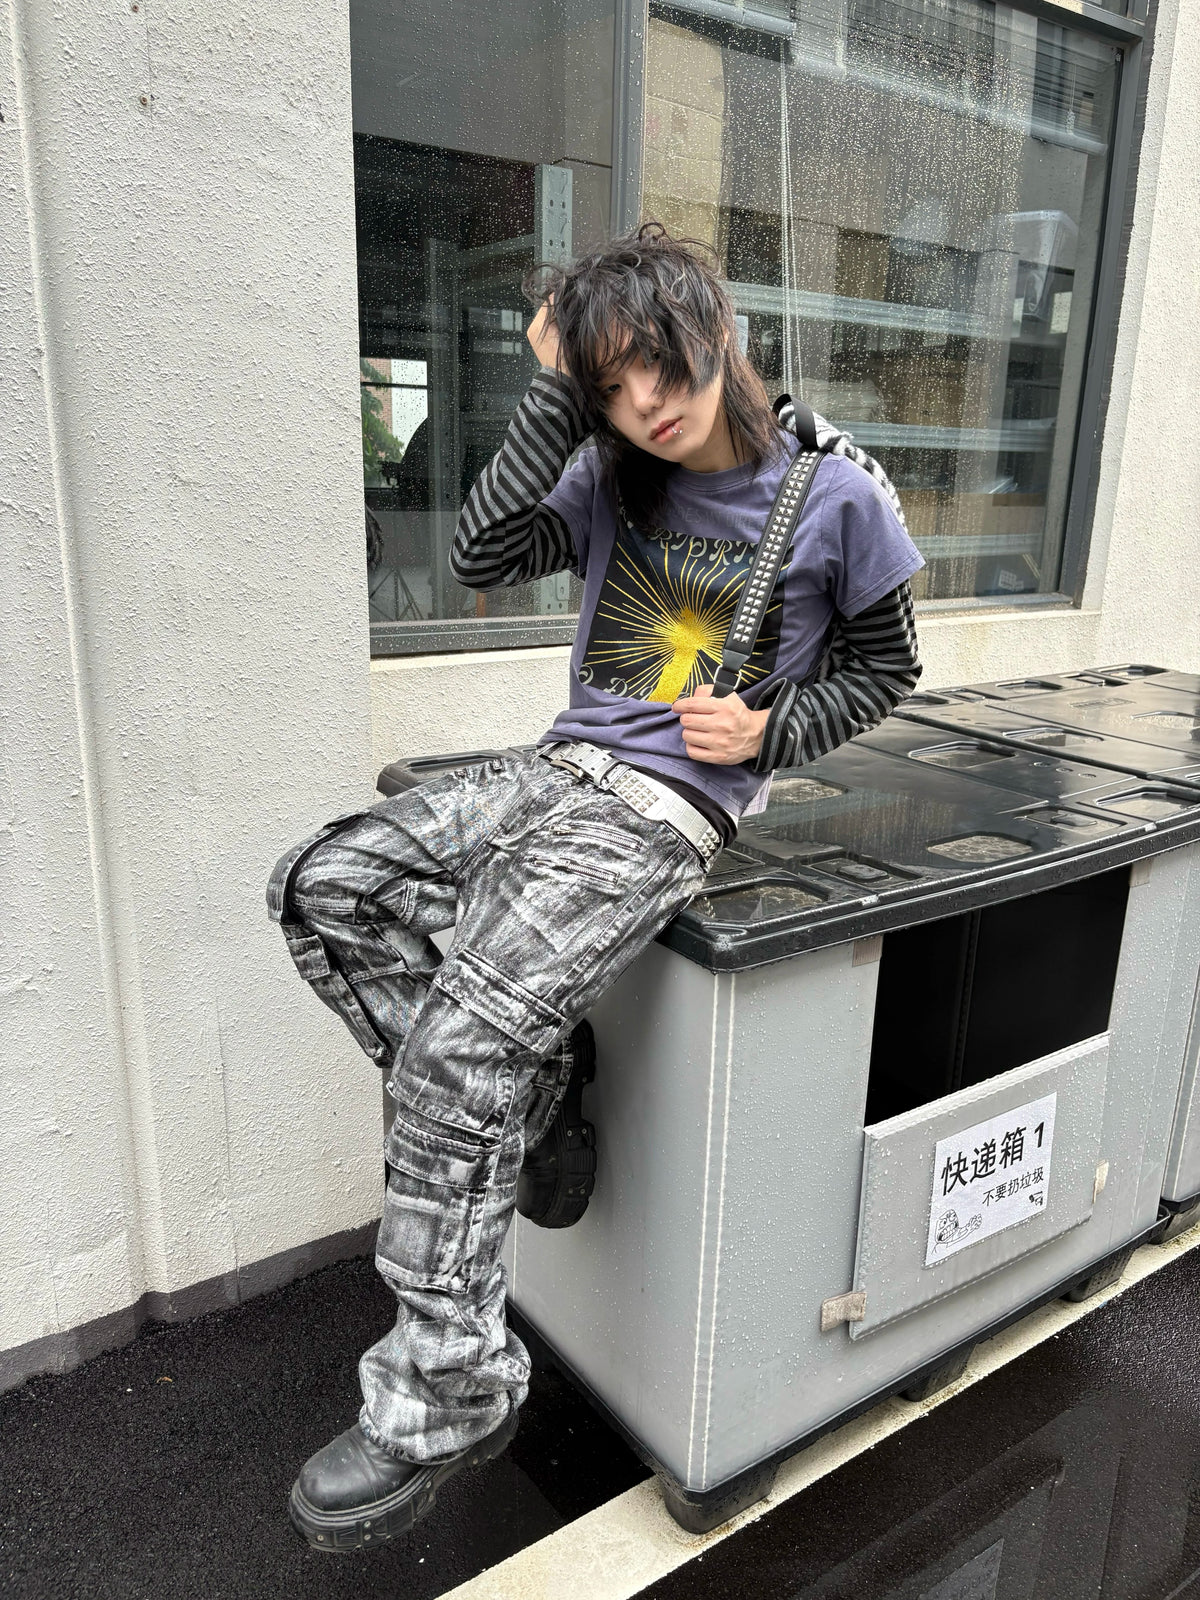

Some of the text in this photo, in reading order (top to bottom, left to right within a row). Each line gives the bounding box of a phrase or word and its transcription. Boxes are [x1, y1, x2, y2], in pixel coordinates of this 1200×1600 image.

[941, 1121, 1045, 1196] 快递箱 1
[982, 1166, 1044, 1207] 不要扔垃圾
